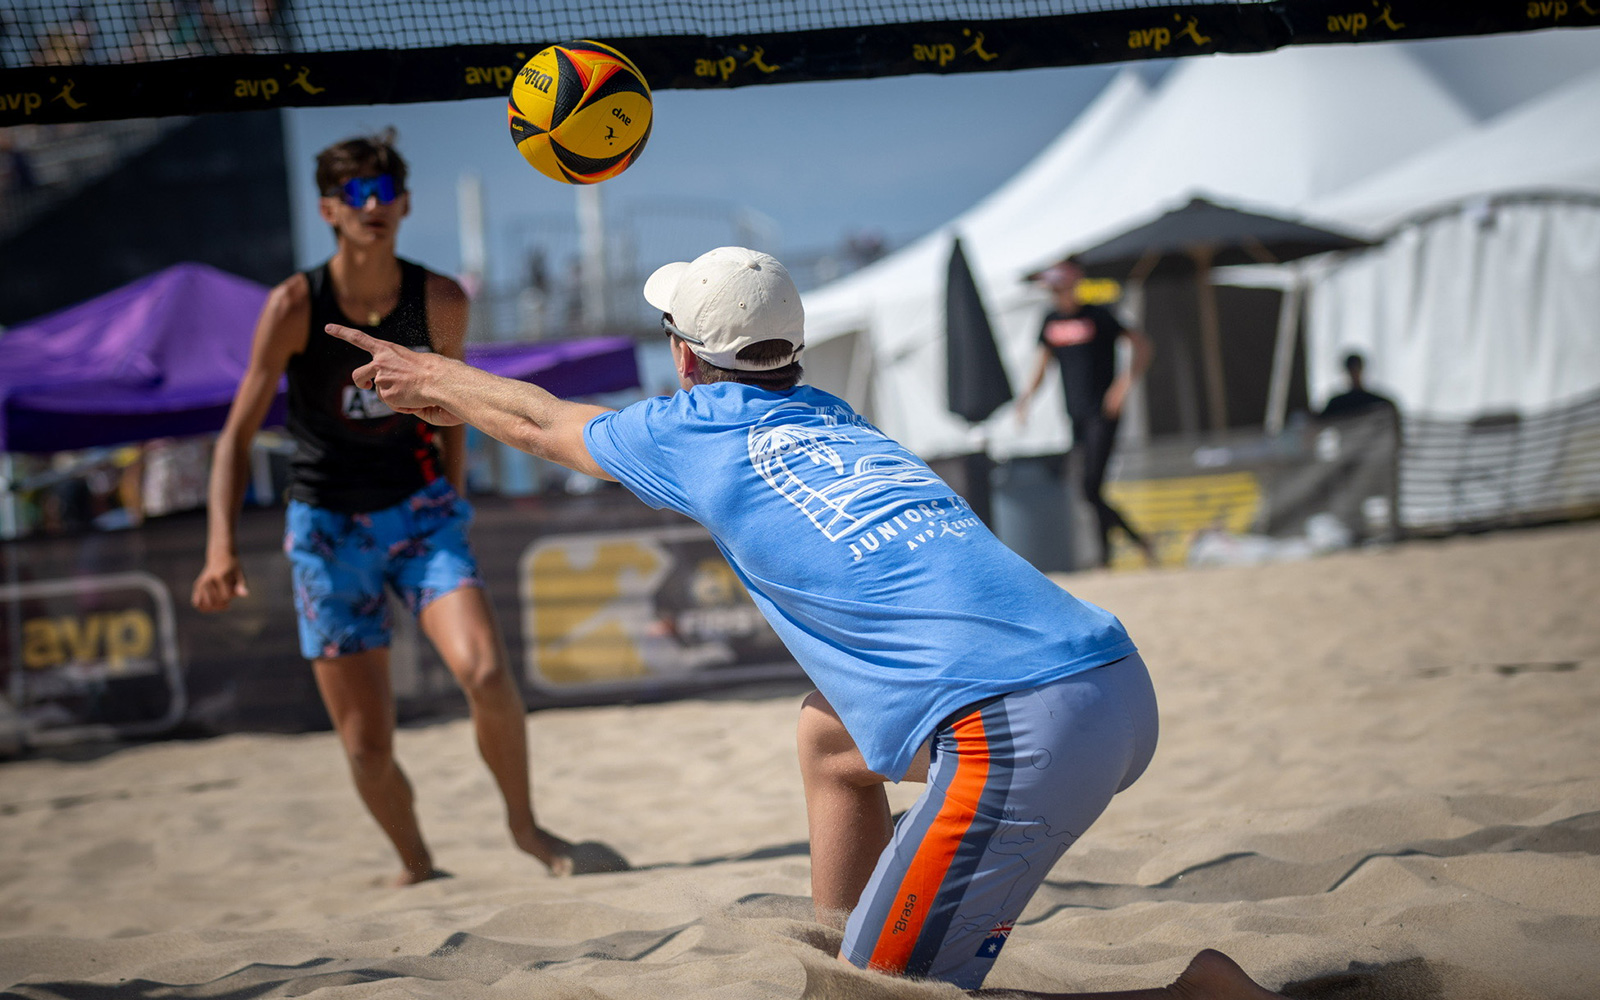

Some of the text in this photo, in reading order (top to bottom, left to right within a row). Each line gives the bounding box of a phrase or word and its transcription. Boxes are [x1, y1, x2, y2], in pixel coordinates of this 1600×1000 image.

[1526, 0, 1568, 21] avp
[1327, 12, 1368, 36] avp
[1127, 27, 1171, 51] avp
[912, 42, 956, 67] avp
[464, 63, 513, 88] avp
[518, 66, 554, 94] Wilso
[694, 55, 737, 81] avp
[234, 77, 280, 101] avp
[611, 107, 632, 127] avp
[848, 499, 946, 562] JUNIORS
[905, 528, 935, 551] AVP
[23, 608, 154, 671] avp
